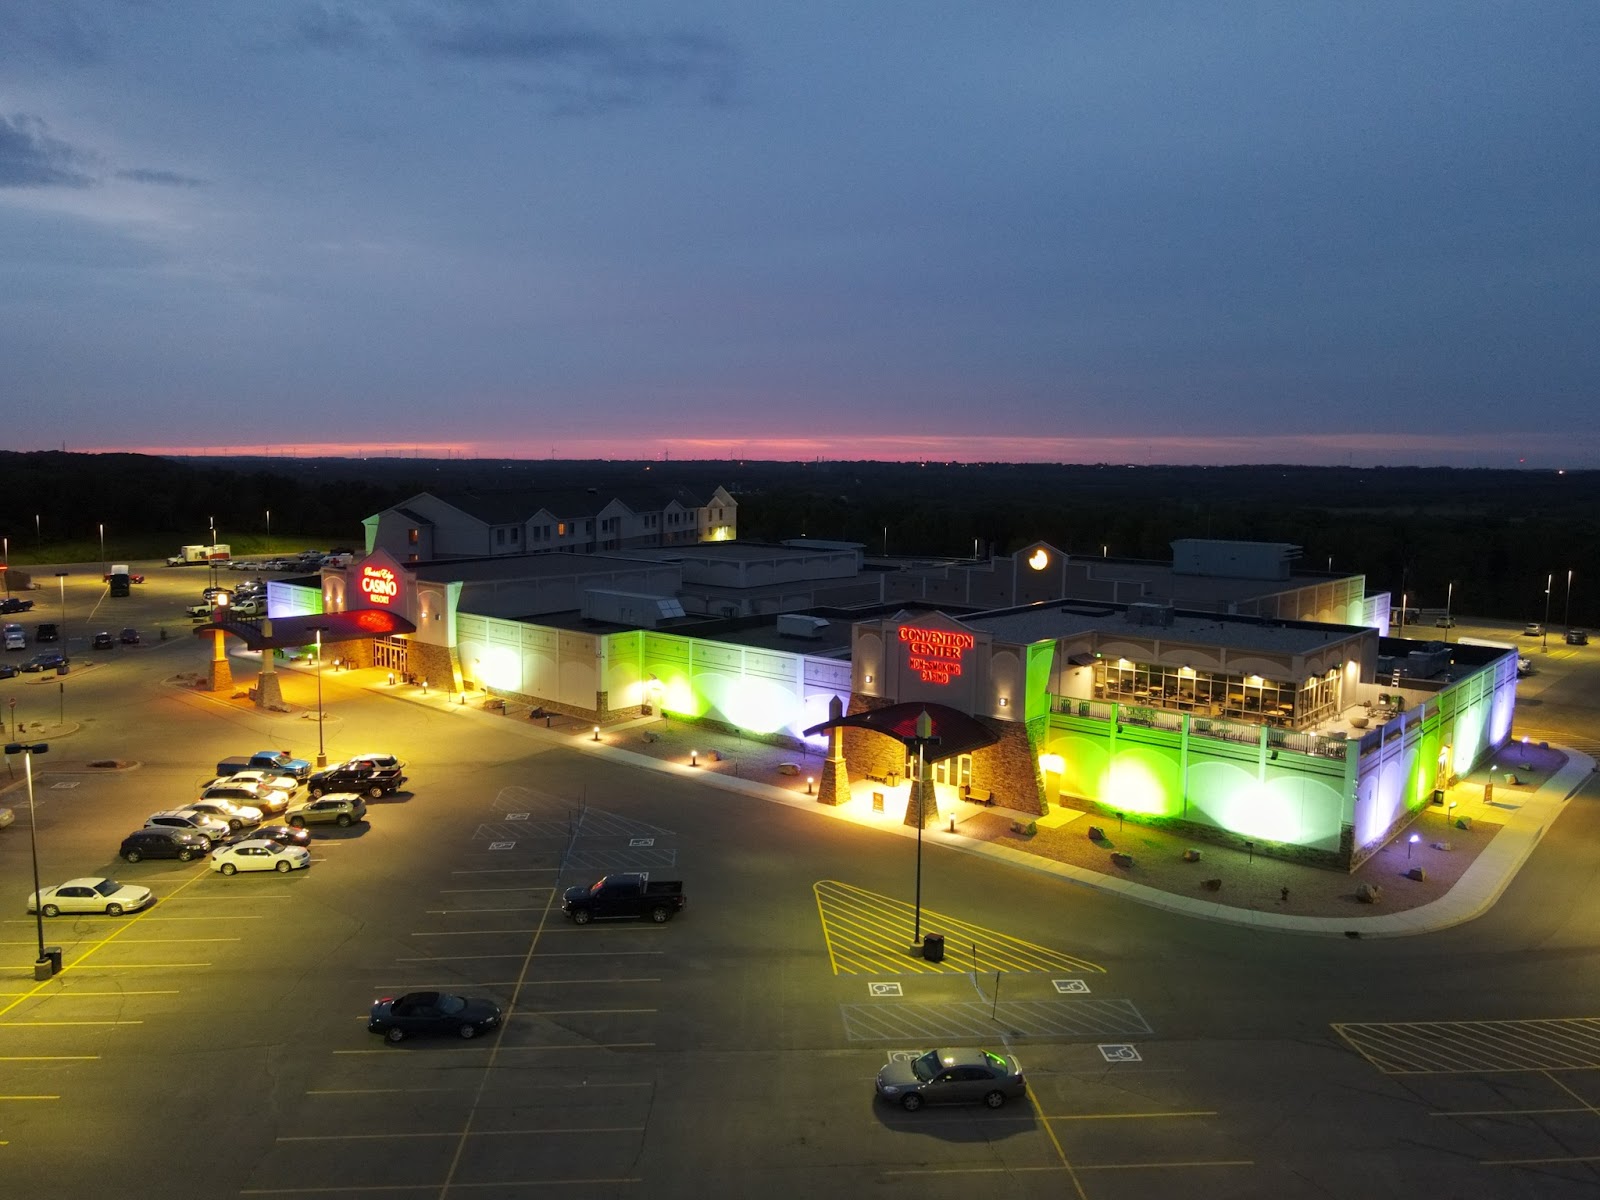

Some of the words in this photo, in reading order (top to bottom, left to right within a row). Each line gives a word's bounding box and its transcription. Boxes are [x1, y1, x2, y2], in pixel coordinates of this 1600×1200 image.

[362, 577, 397, 596] CASINO
[899, 627, 974, 649] CONVENTION
[910, 641, 961, 659] CENTER
[909, 657, 961, 675] NON-SMOKING
[921, 669, 949, 684] CASINO
